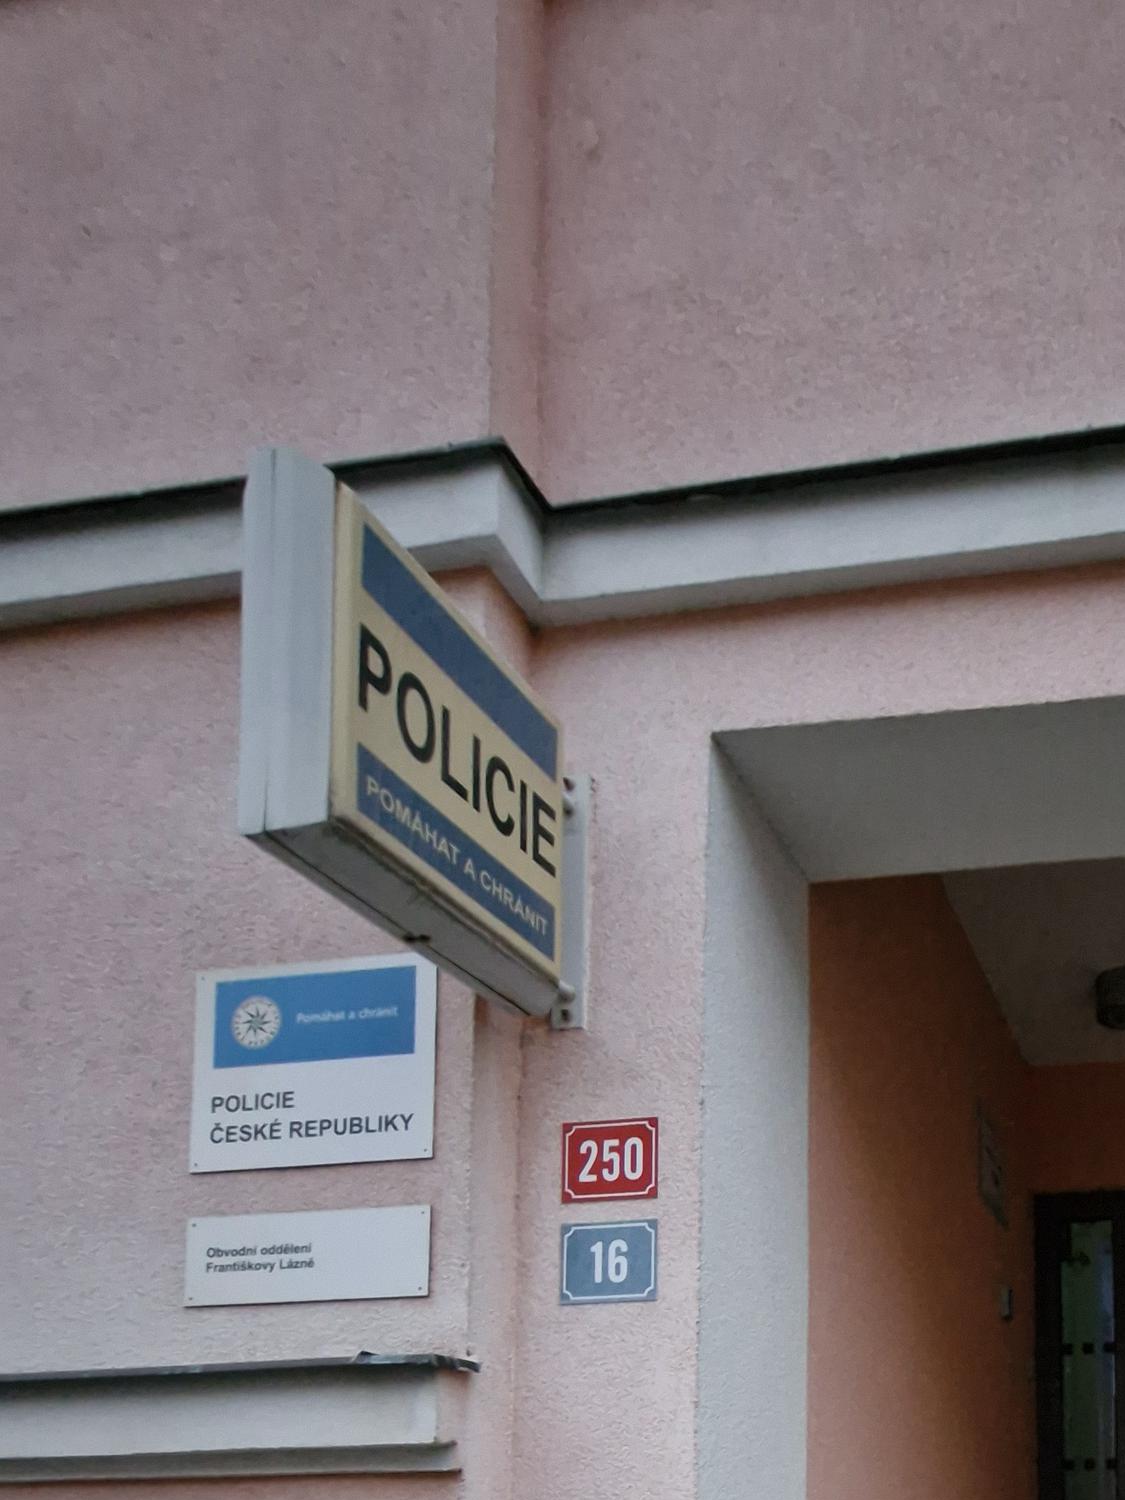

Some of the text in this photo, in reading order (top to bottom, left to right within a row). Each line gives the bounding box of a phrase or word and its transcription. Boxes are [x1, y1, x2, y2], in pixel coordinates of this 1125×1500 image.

[358, 622, 556, 878] POLICIE
[366, 774, 549, 937] POMÁHAT A CHRÁNIT
[296, 1006, 400, 1024] Pomáhat a chránit
[211, 1091, 296, 1114] POLICIE
[209, 1113, 415, 1144] ČESKÉ REPUBLIKY
[578, 1136, 644, 1183] 250
[205, 1257, 316, 1274] Františkovy Lázně
[206, 1242, 313, 1258] Obvodní oddělení
[590, 1239, 629, 1284] 16
